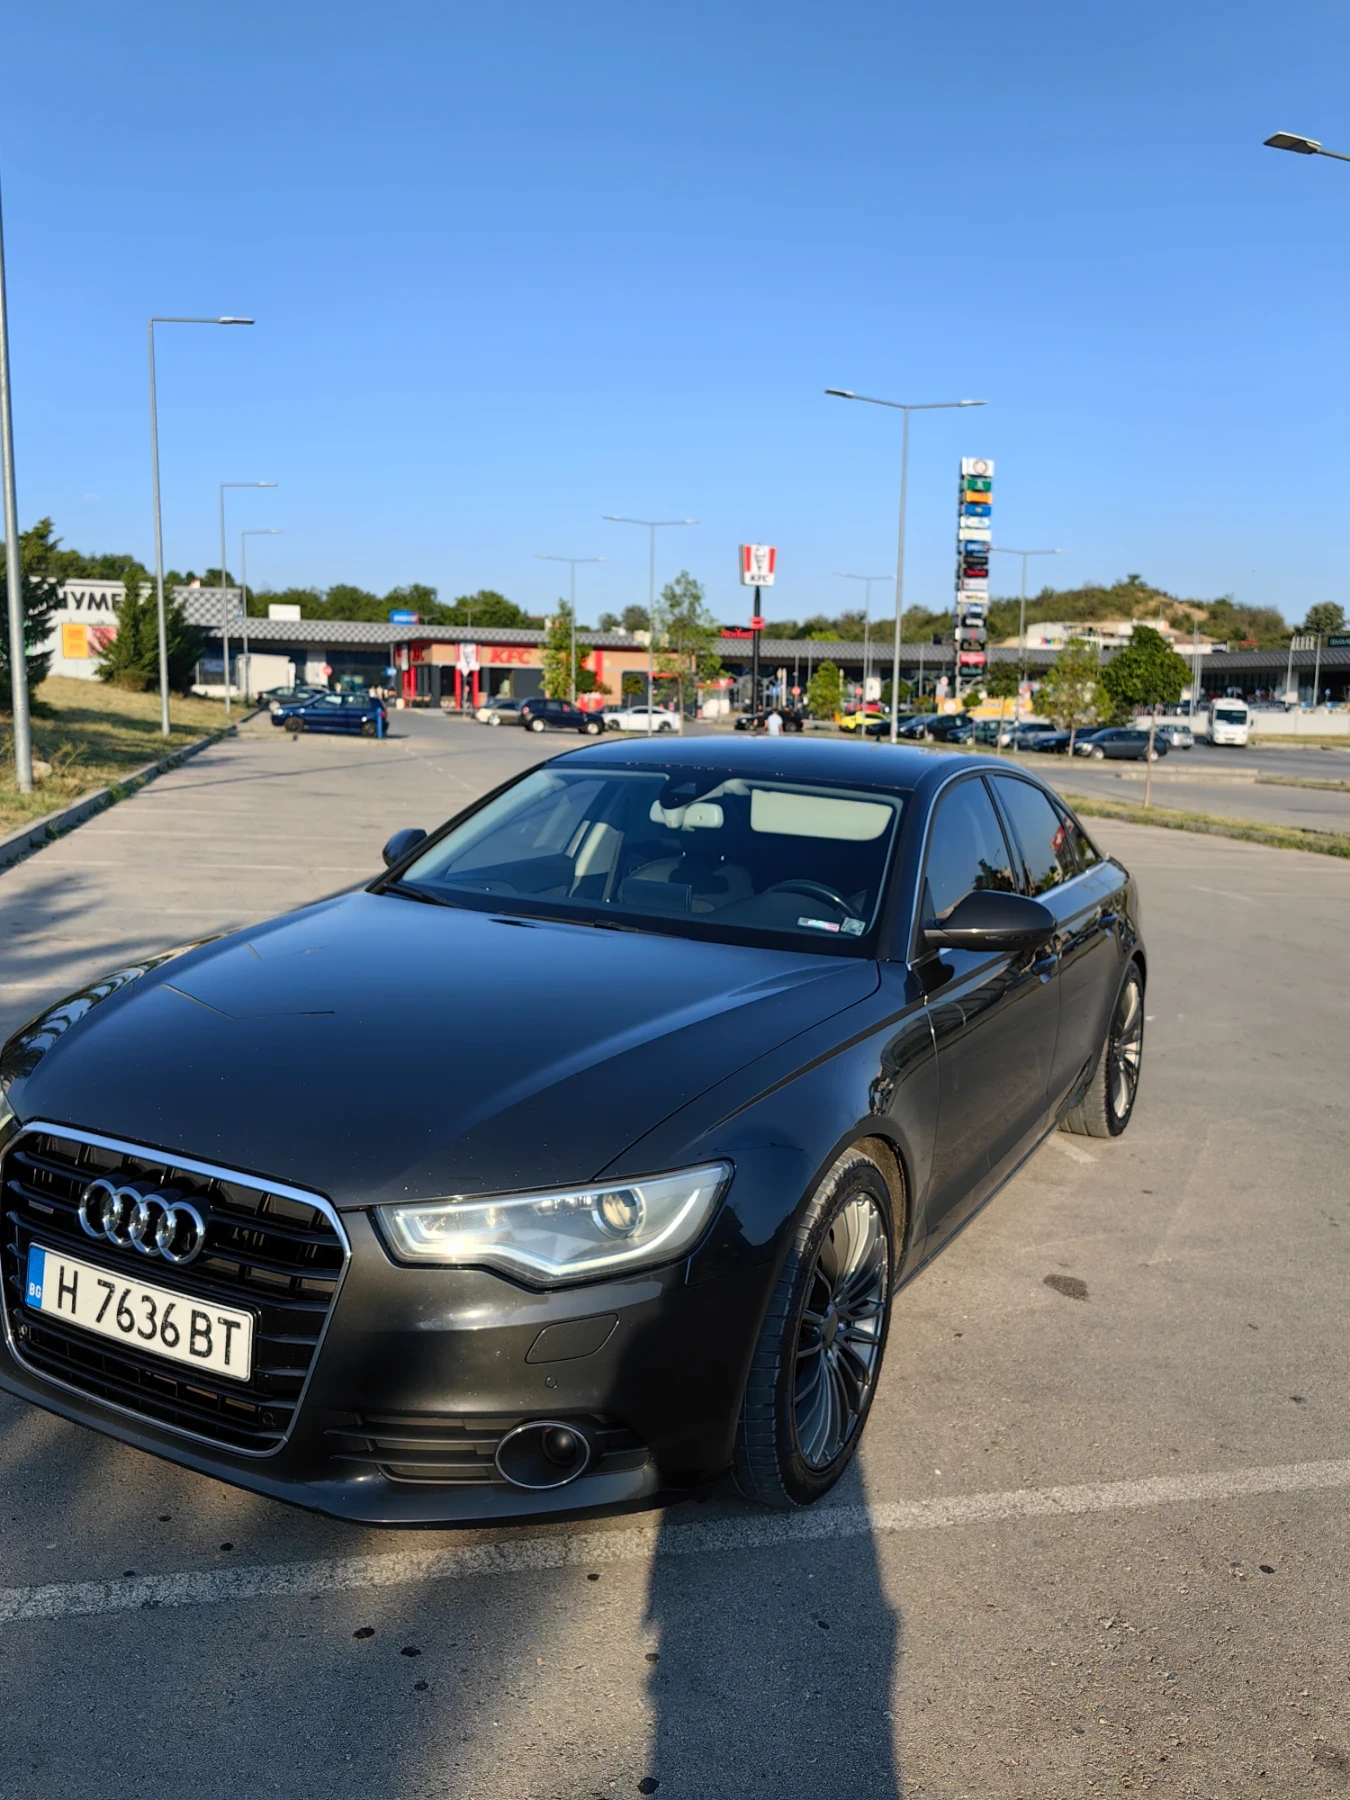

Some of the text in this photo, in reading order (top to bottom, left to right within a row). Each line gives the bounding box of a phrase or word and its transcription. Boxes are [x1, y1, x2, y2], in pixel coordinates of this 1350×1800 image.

[489, 648, 532, 664] KFC
[29, 1282, 42, 1299] BG
[57, 1265, 241, 1365] H 7636 BT
